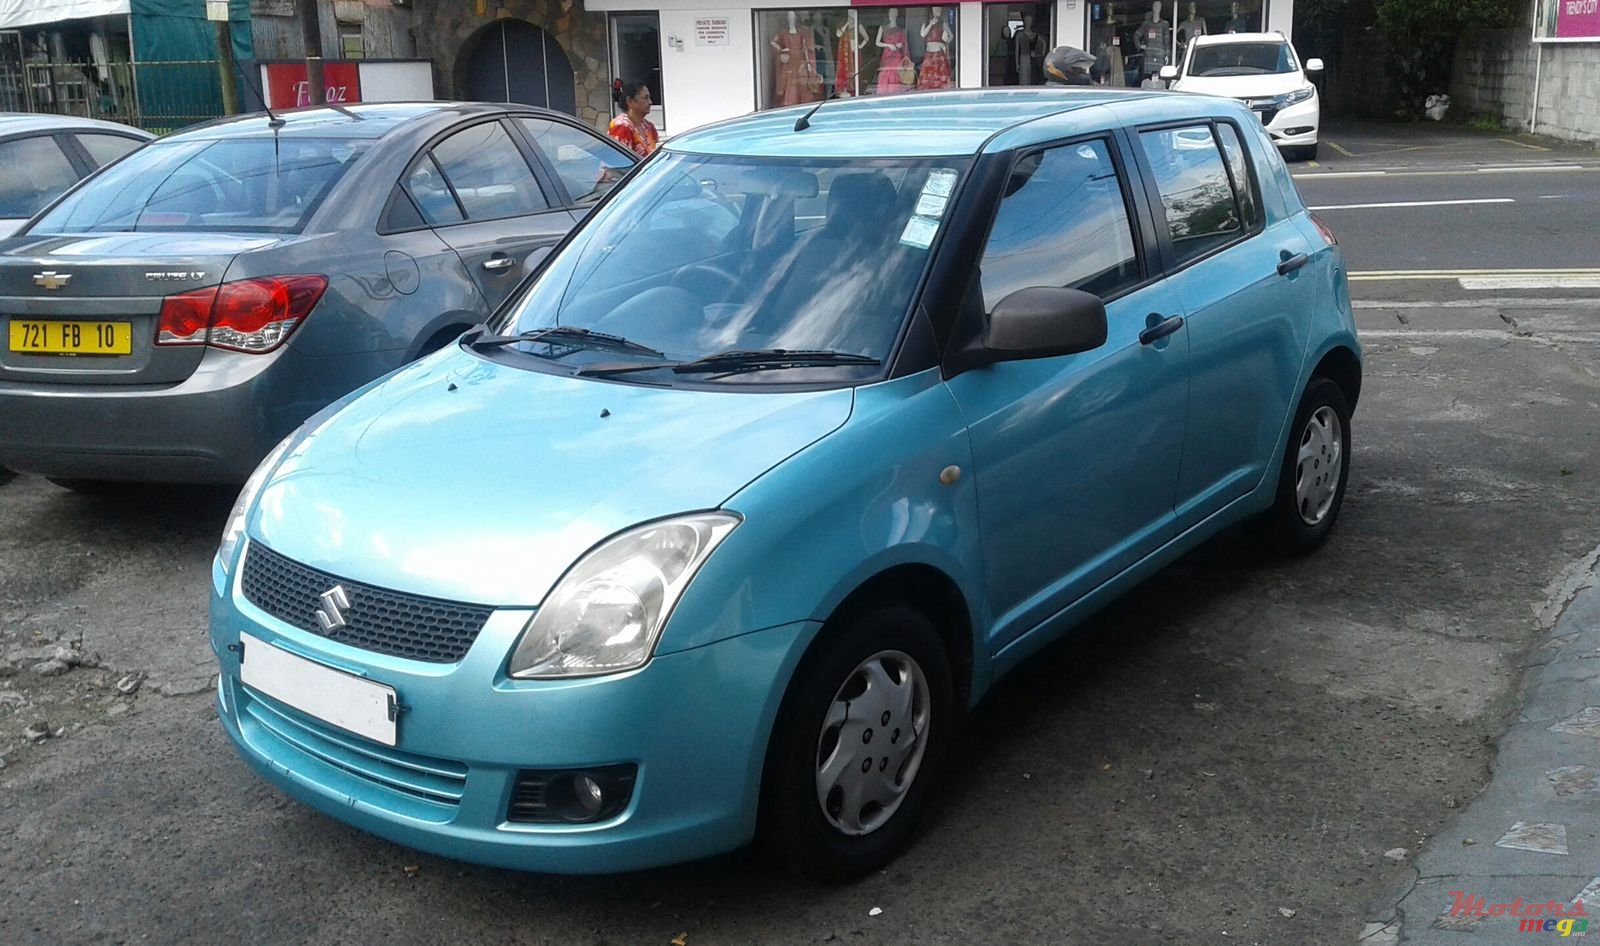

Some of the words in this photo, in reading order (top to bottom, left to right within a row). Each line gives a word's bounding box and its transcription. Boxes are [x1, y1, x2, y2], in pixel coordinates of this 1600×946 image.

[22, 323, 47, 348] 721
[62, 324, 81, 348] FB
[96, 324, 115, 348] 10
